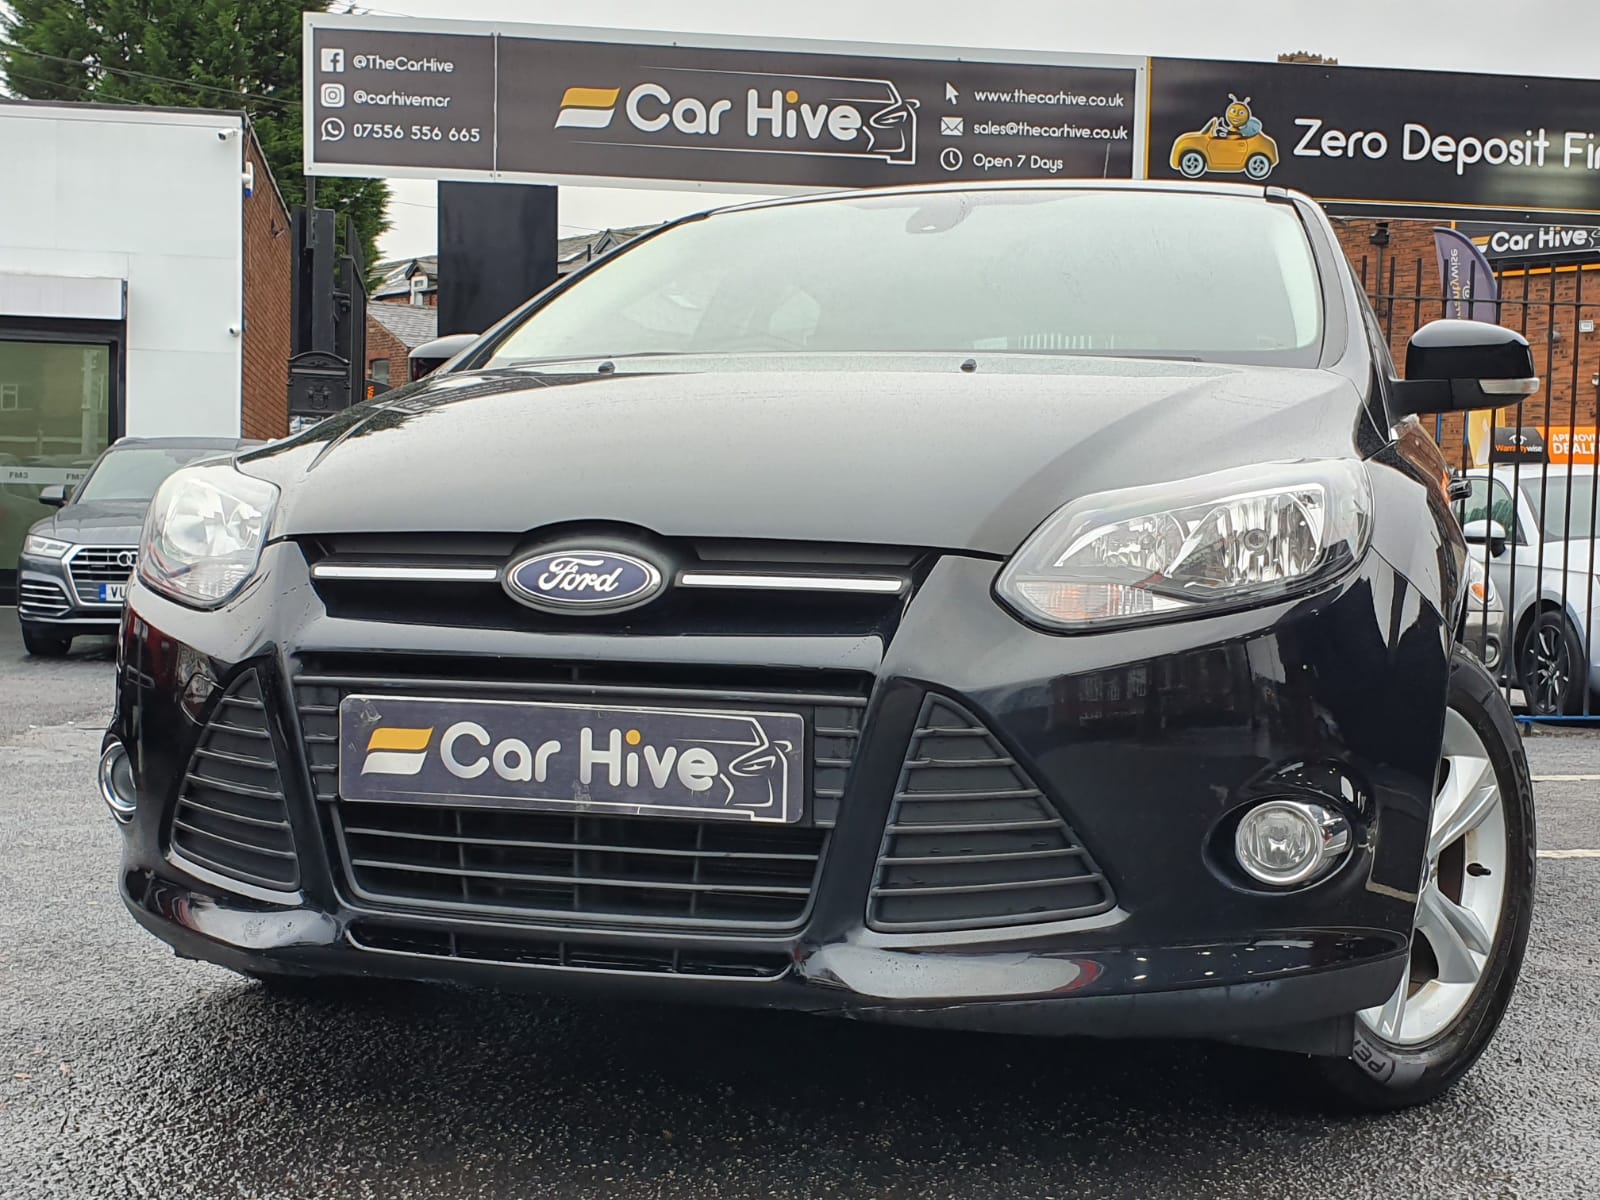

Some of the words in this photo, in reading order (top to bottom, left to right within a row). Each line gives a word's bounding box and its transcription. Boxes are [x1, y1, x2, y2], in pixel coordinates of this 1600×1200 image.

[352, 54, 454, 73] @TheCarHive
[353, 90, 451, 107] @carhivemcr
[974, 88, 1124, 107] www.thecarhive.co.uk
[626, 83, 732, 135] Car
[747, 88, 862, 141] Hive
[353, 123, 404, 139] 07556
[410, 125, 442, 141] 556
[448, 127, 480, 142] 665
[973, 120, 1128, 140] sales@thecarhive.co.uk
[1293, 118, 1388, 159] Zero
[1402, 123, 1550, 175] Deposit
[1563, 132, 1600, 170] Fi
[972, 153, 1013, 171] Open
[1017, 154, 1027, 168] 7
[1030, 155, 1063, 174] Days
[1491, 231, 1534, 252] Car
[1538, 226, 1588, 249] Hive
[1552, 442, 1597, 454] DEALE
[537, 556, 622, 594] Ford
[439, 721, 562, 783] Car
[579, 727, 720, 793] Hive
